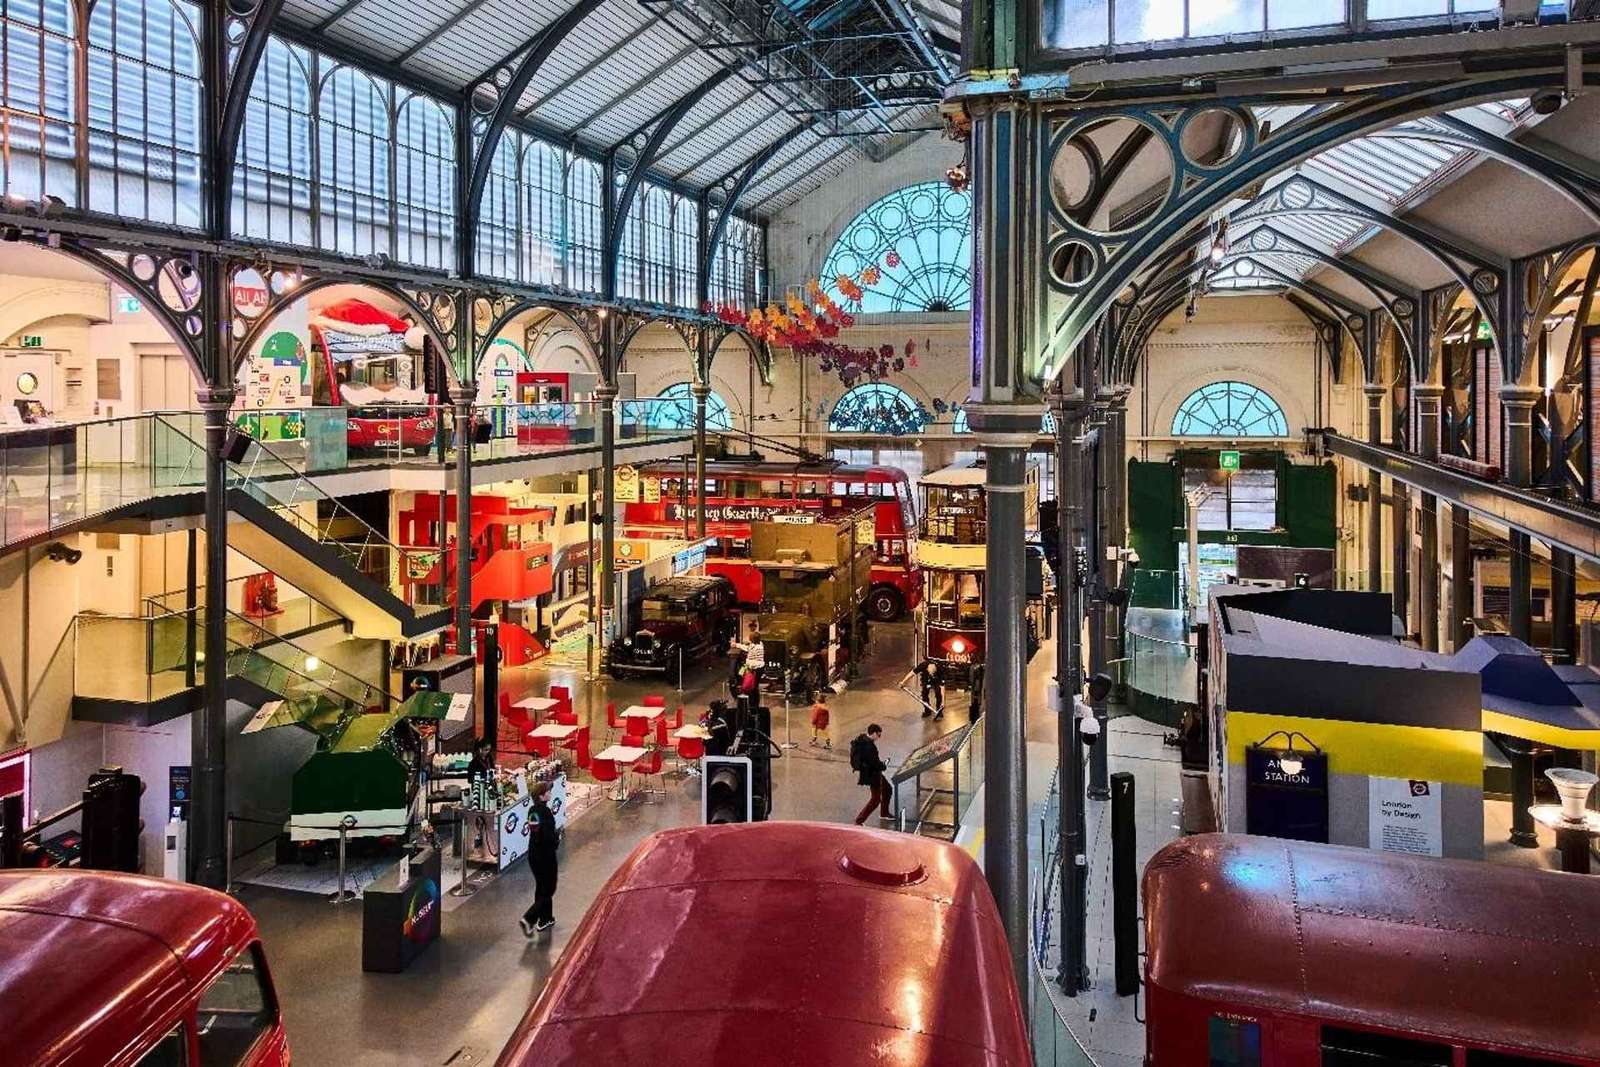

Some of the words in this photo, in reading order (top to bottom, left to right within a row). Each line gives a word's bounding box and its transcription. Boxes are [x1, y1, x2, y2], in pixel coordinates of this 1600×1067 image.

[1299, 577, 1305, 585] 6
[1264, 771, 1310, 784] STATION
[1122, 782, 1129, 795] 7
